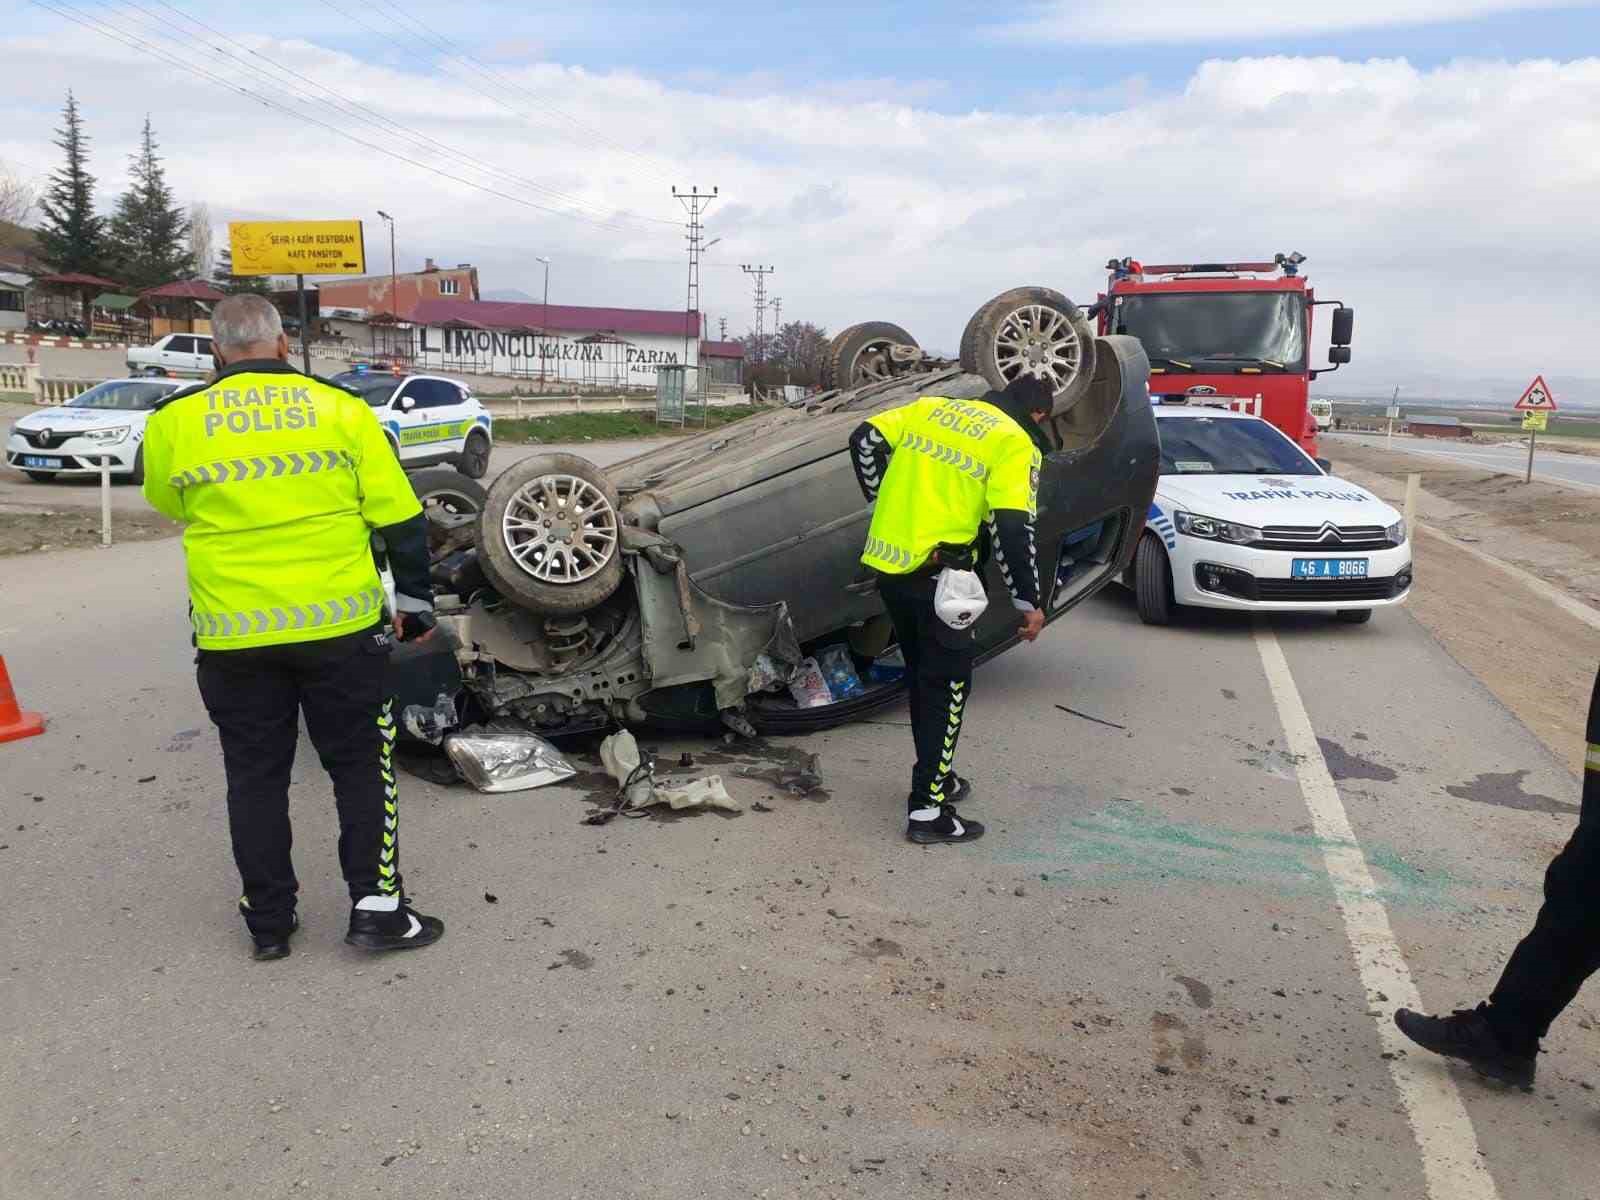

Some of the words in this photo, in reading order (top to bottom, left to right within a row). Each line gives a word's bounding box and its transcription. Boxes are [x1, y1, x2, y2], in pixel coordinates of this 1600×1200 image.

[626, 348, 678, 364] TARIM
[1300, 561, 1316, 576] 46
[1323, 561, 1330, 576] A
[1338, 560, 1366, 576] 8066
